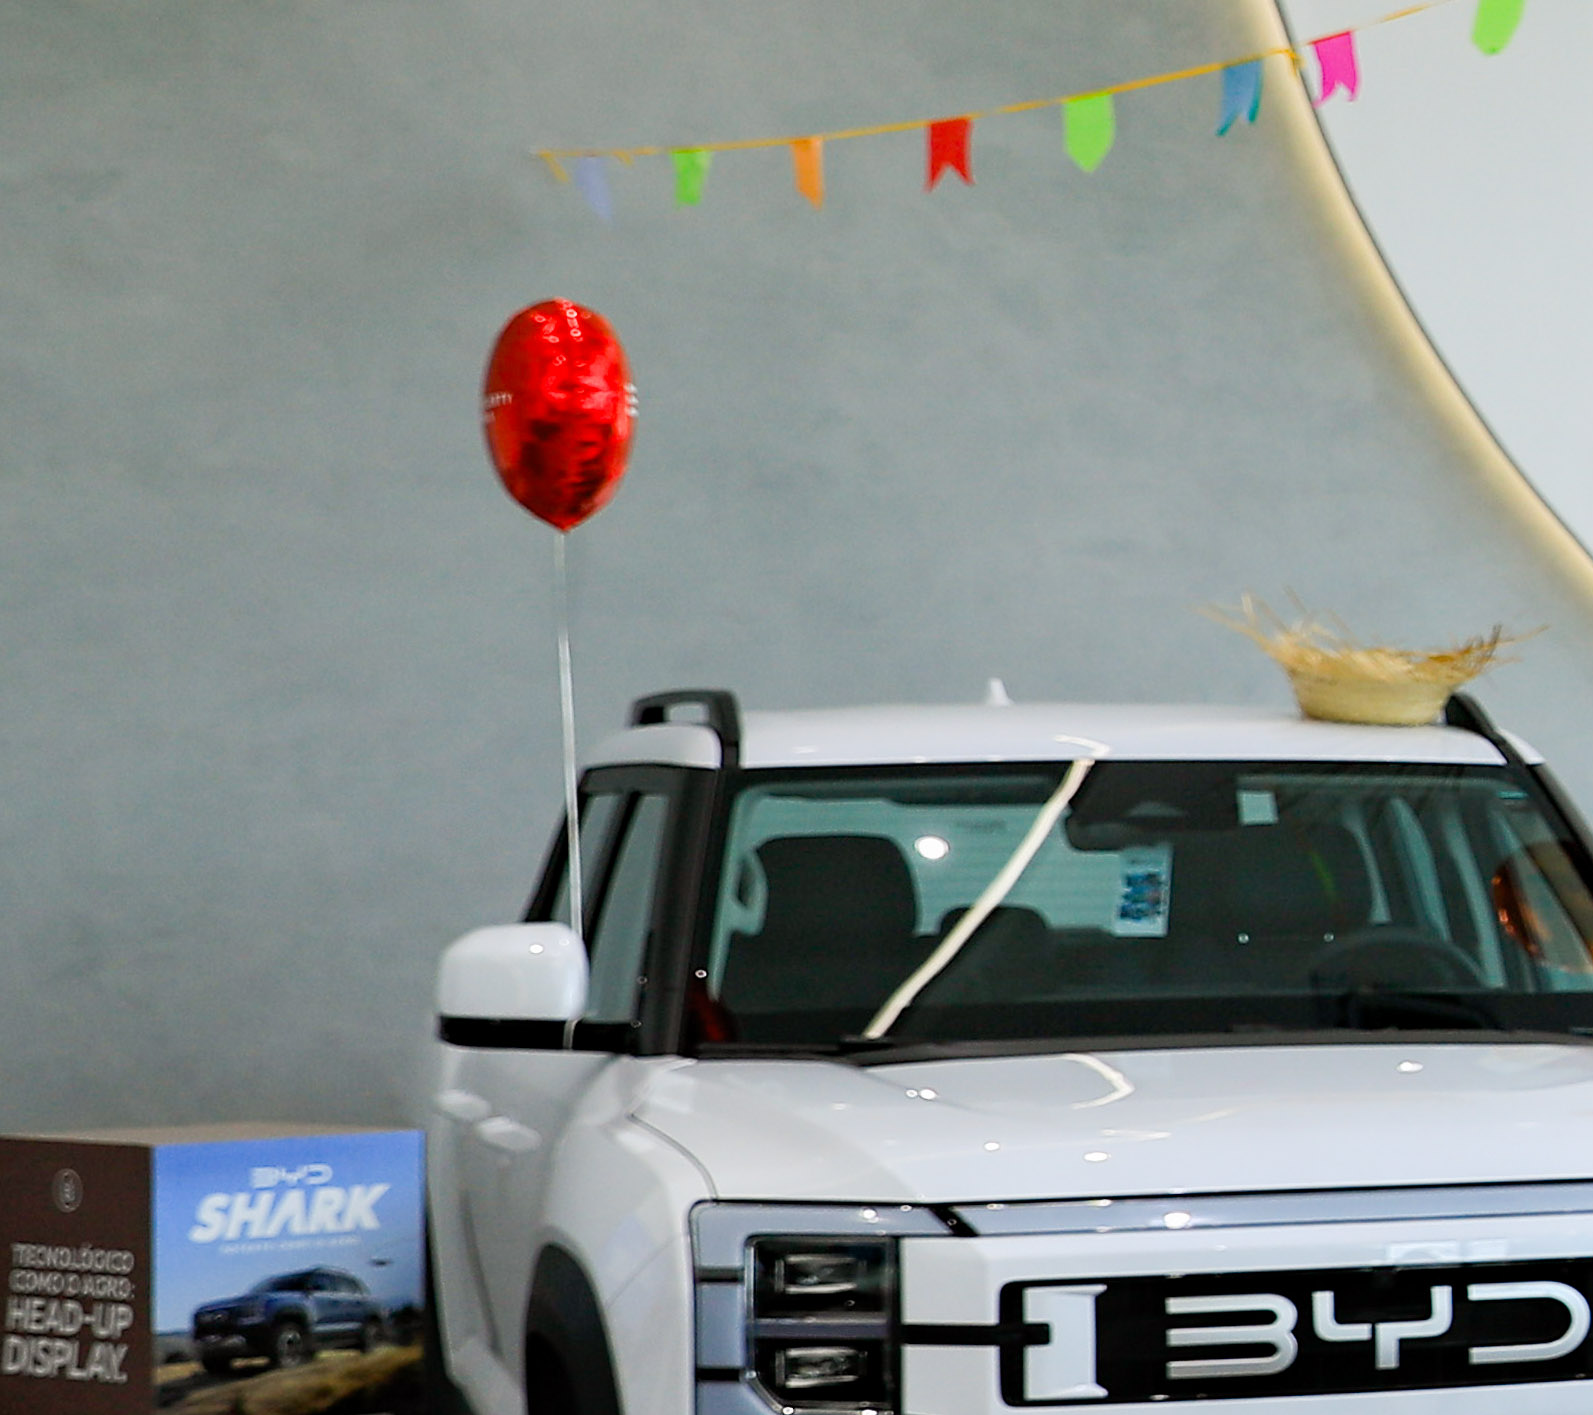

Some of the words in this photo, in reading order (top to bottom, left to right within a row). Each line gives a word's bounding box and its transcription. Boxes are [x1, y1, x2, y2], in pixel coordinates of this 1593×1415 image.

[189, 1183, 391, 1244] SHARK
[11, 1243, 135, 1275] TECNOLÓGICO
[6, 1296, 134, 1339] HEAD-UP
[1165, 1281, 1591, 1379] BYD
